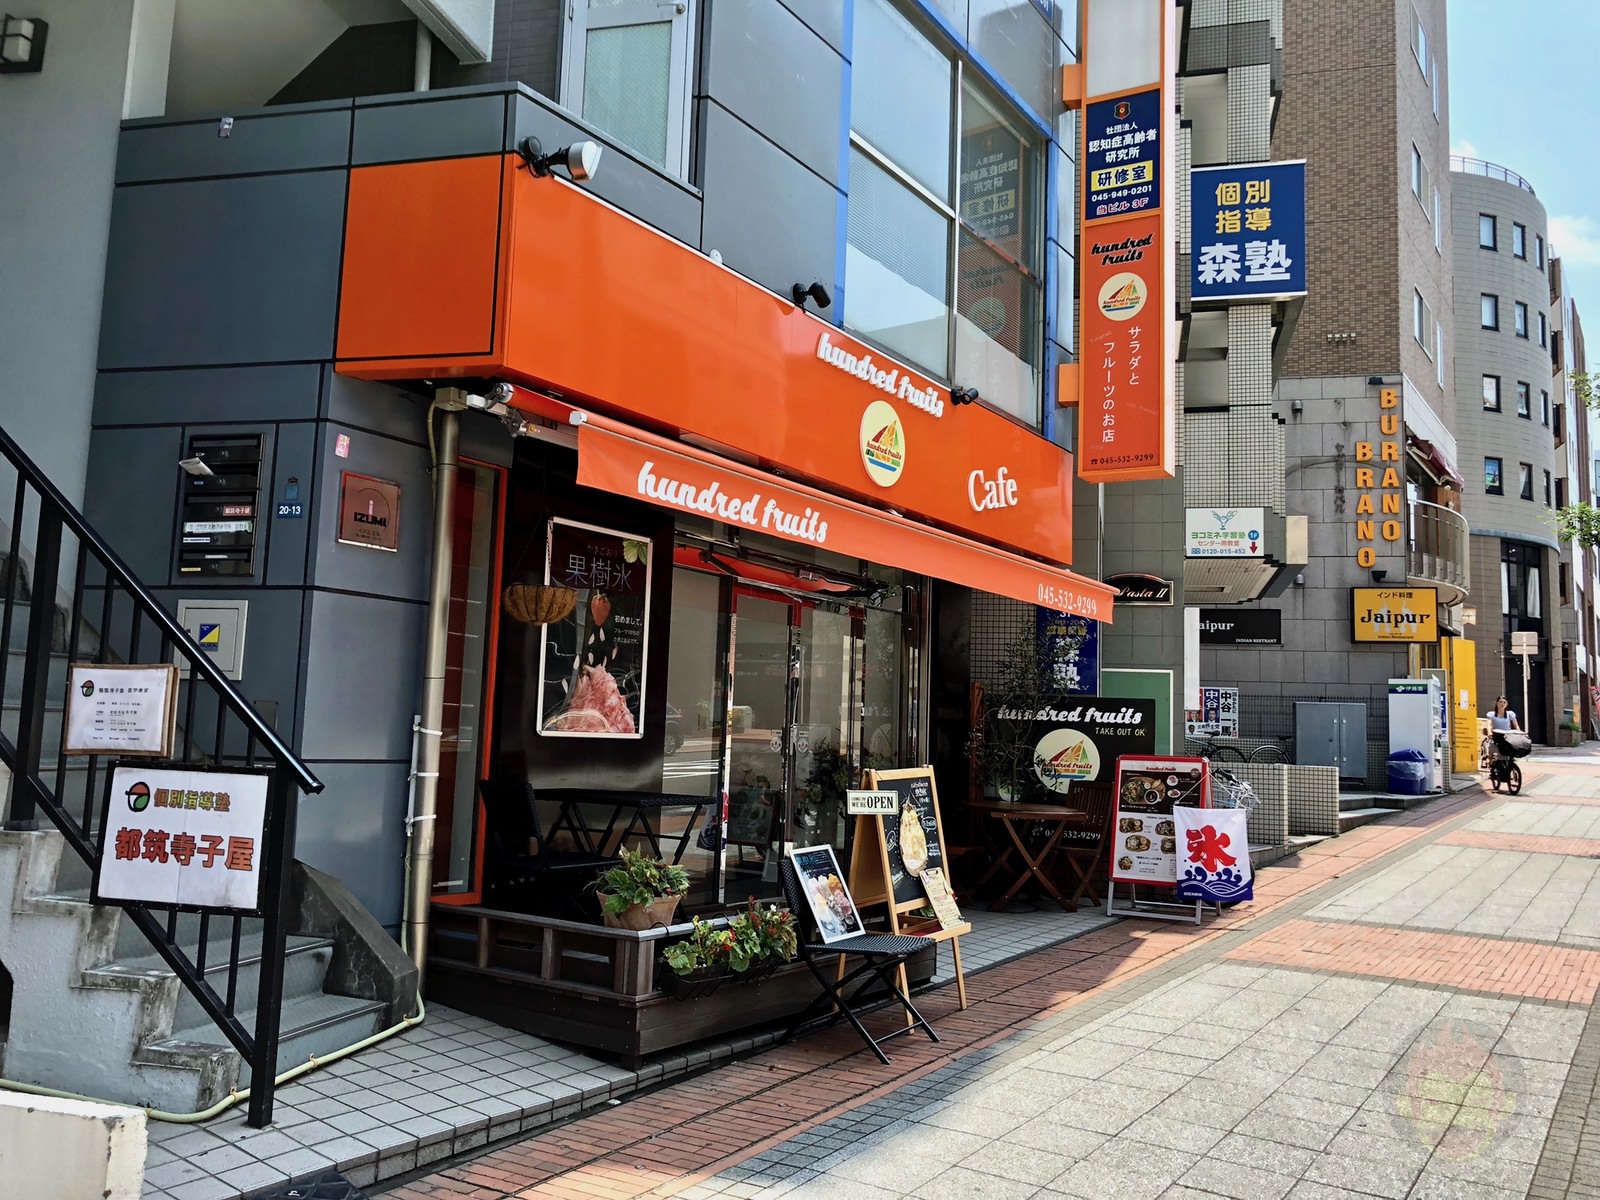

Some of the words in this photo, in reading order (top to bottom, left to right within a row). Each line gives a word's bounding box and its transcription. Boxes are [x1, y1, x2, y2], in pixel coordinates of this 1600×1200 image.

[1089, 128, 1157, 153] 認知症高齢者
[1106, 121, 1138, 135] 社団法人
[1105, 146, 1140, 163] 研究所
[1097, 165, 1147, 187] 研修室
[1091, 184, 1153, 202] 045-949-0201
[1215, 179, 1271, 206] 個別
[1096, 200, 1130, 216] 当ビル
[1131, 196, 1150, 209] 3F
[1215, 207, 1271, 235] 指導
[1091, 232, 1154, 256] hundred
[1101, 249, 1143, 267] fruits
[1198, 239, 1292, 284] 森塾
[1127, 325, 1142, 386] サラダと
[817, 332, 899, 394] hundred
[897, 376, 945, 418] fruits
[1101, 340, 1117, 444] フルーツのお店
[1099, 453, 1155, 466] 045-532-9299
[1380, 388, 1401, 542] BURANO
[638, 460, 761, 526] hundred
[761, 499, 828, 544] fruits
[967, 466, 1018, 513] Cafe
[278, 505, 301, 515] 20-13
[1355, 441, 1376, 569] BRANO
[354, 512, 387, 527] IZUMI
[565, 554, 632, 592] 果樹氷
[1037, 582, 1097, 616] 045-532-9299
[1360, 609, 1430, 628] Jaipur
[1206, 690, 1218, 708] 中谷
[1083, 706, 1143, 725] fruits
[1095, 726, 1115, 736] TAKE
[1116, 727, 1133, 736] OUT
[1134, 728, 1146, 737] OK
[153, 787, 232, 813] 個別指導塾
[866, 796, 894, 809] OPEN
[115, 826, 255, 872] 都筑寺子屋
[1186, 824, 1238, 873] 氷
